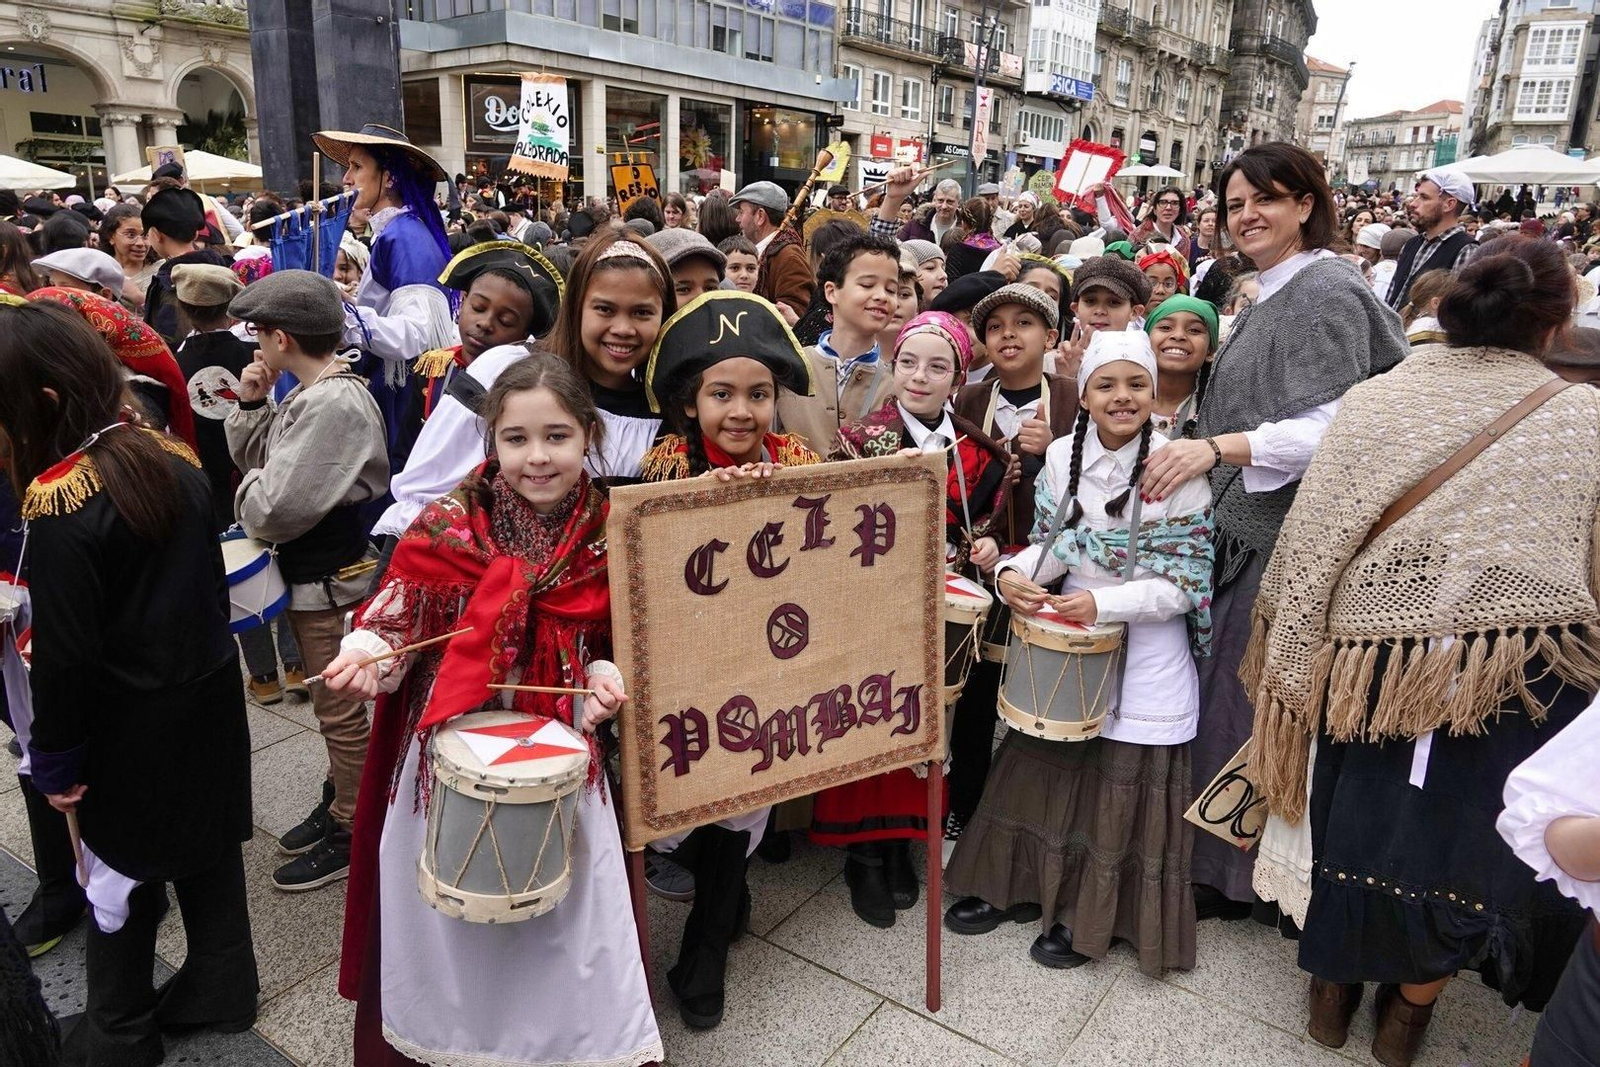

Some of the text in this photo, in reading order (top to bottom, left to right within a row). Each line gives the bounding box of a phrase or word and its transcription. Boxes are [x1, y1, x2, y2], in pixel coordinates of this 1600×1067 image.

[32, 24, 39, 35] 6
[709, 311, 748, 345] N
[766, 602, 809, 660] O
